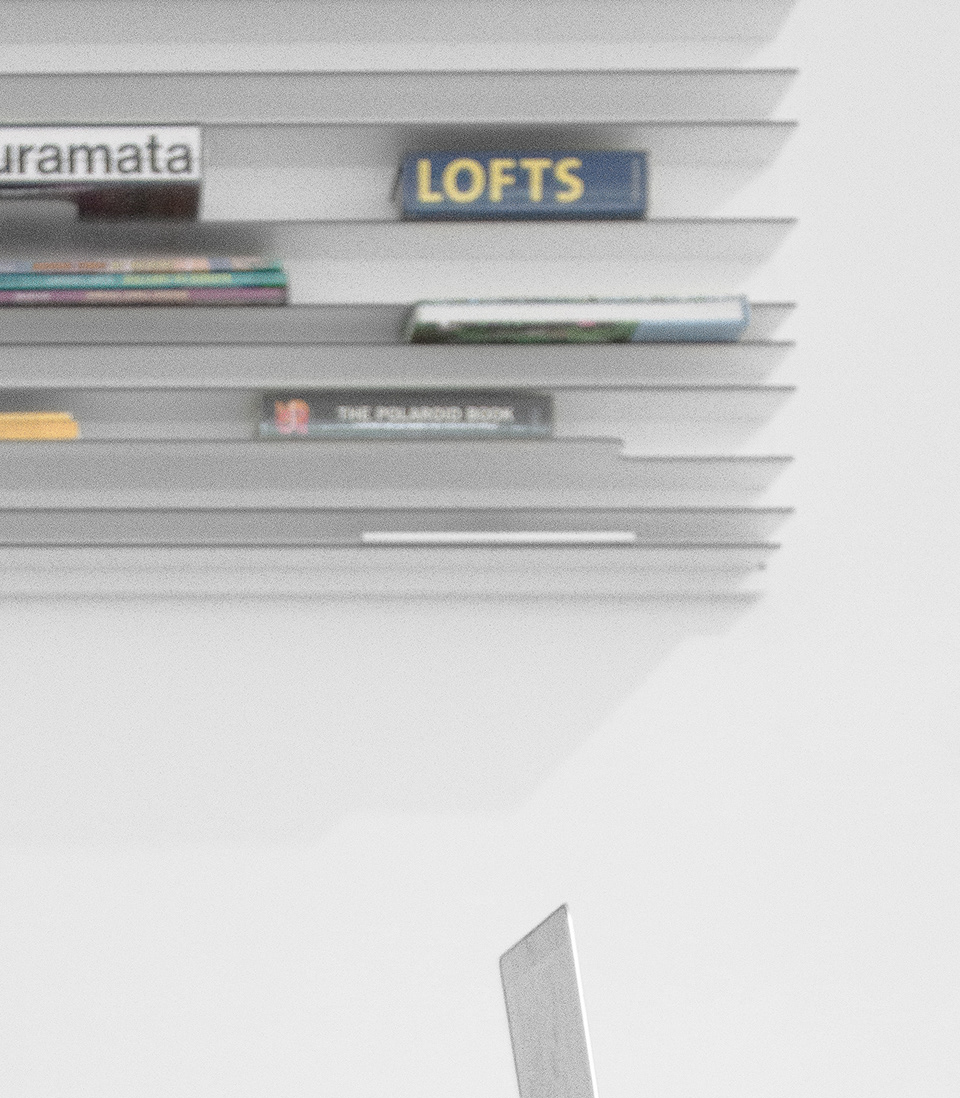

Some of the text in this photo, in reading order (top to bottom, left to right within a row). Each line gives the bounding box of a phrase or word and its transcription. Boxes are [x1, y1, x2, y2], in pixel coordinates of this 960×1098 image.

[416, 157, 585, 204] LOFTS
[338, 404, 515, 423] THE POLAROID BOOK
